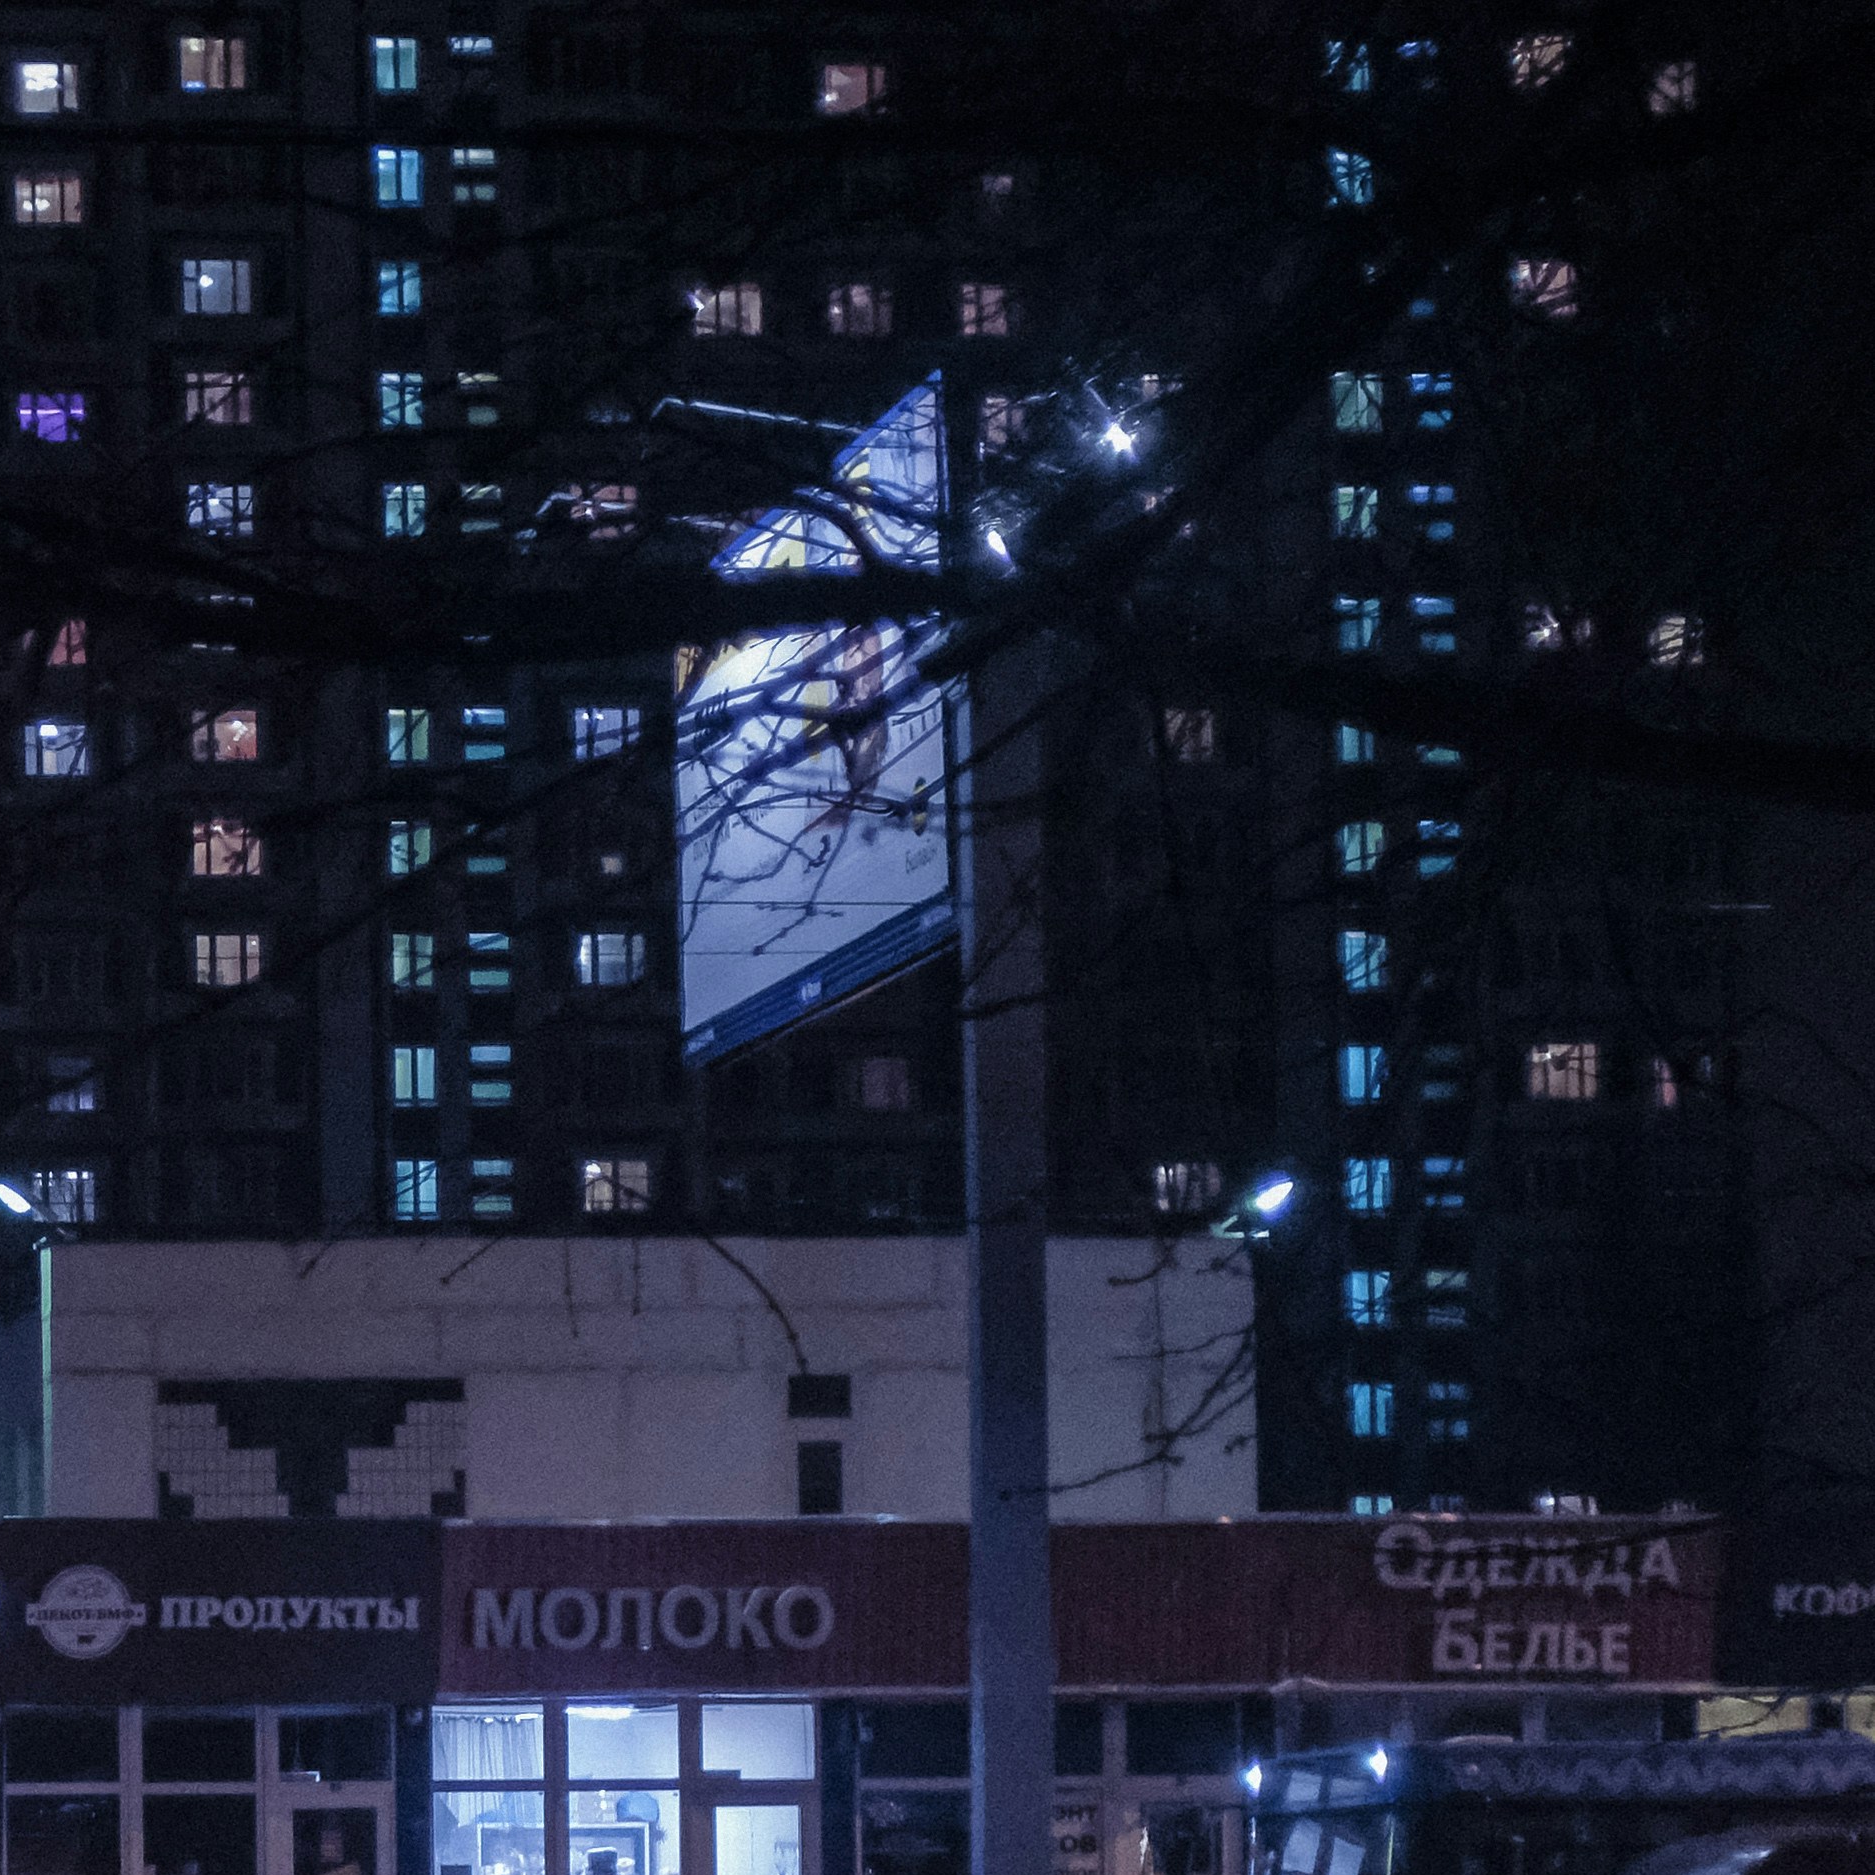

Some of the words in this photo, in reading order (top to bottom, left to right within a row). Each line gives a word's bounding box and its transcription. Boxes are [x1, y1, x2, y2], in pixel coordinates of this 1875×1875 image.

[159, 1594, 420, 1633] ПРОДУКТЫ
[470, 1585, 835, 1652] МОЛОКО
[1772, 1579, 1875, 1615] КОФ
[1432, 1608, 1632, 1674] БЕЛЬЕ
